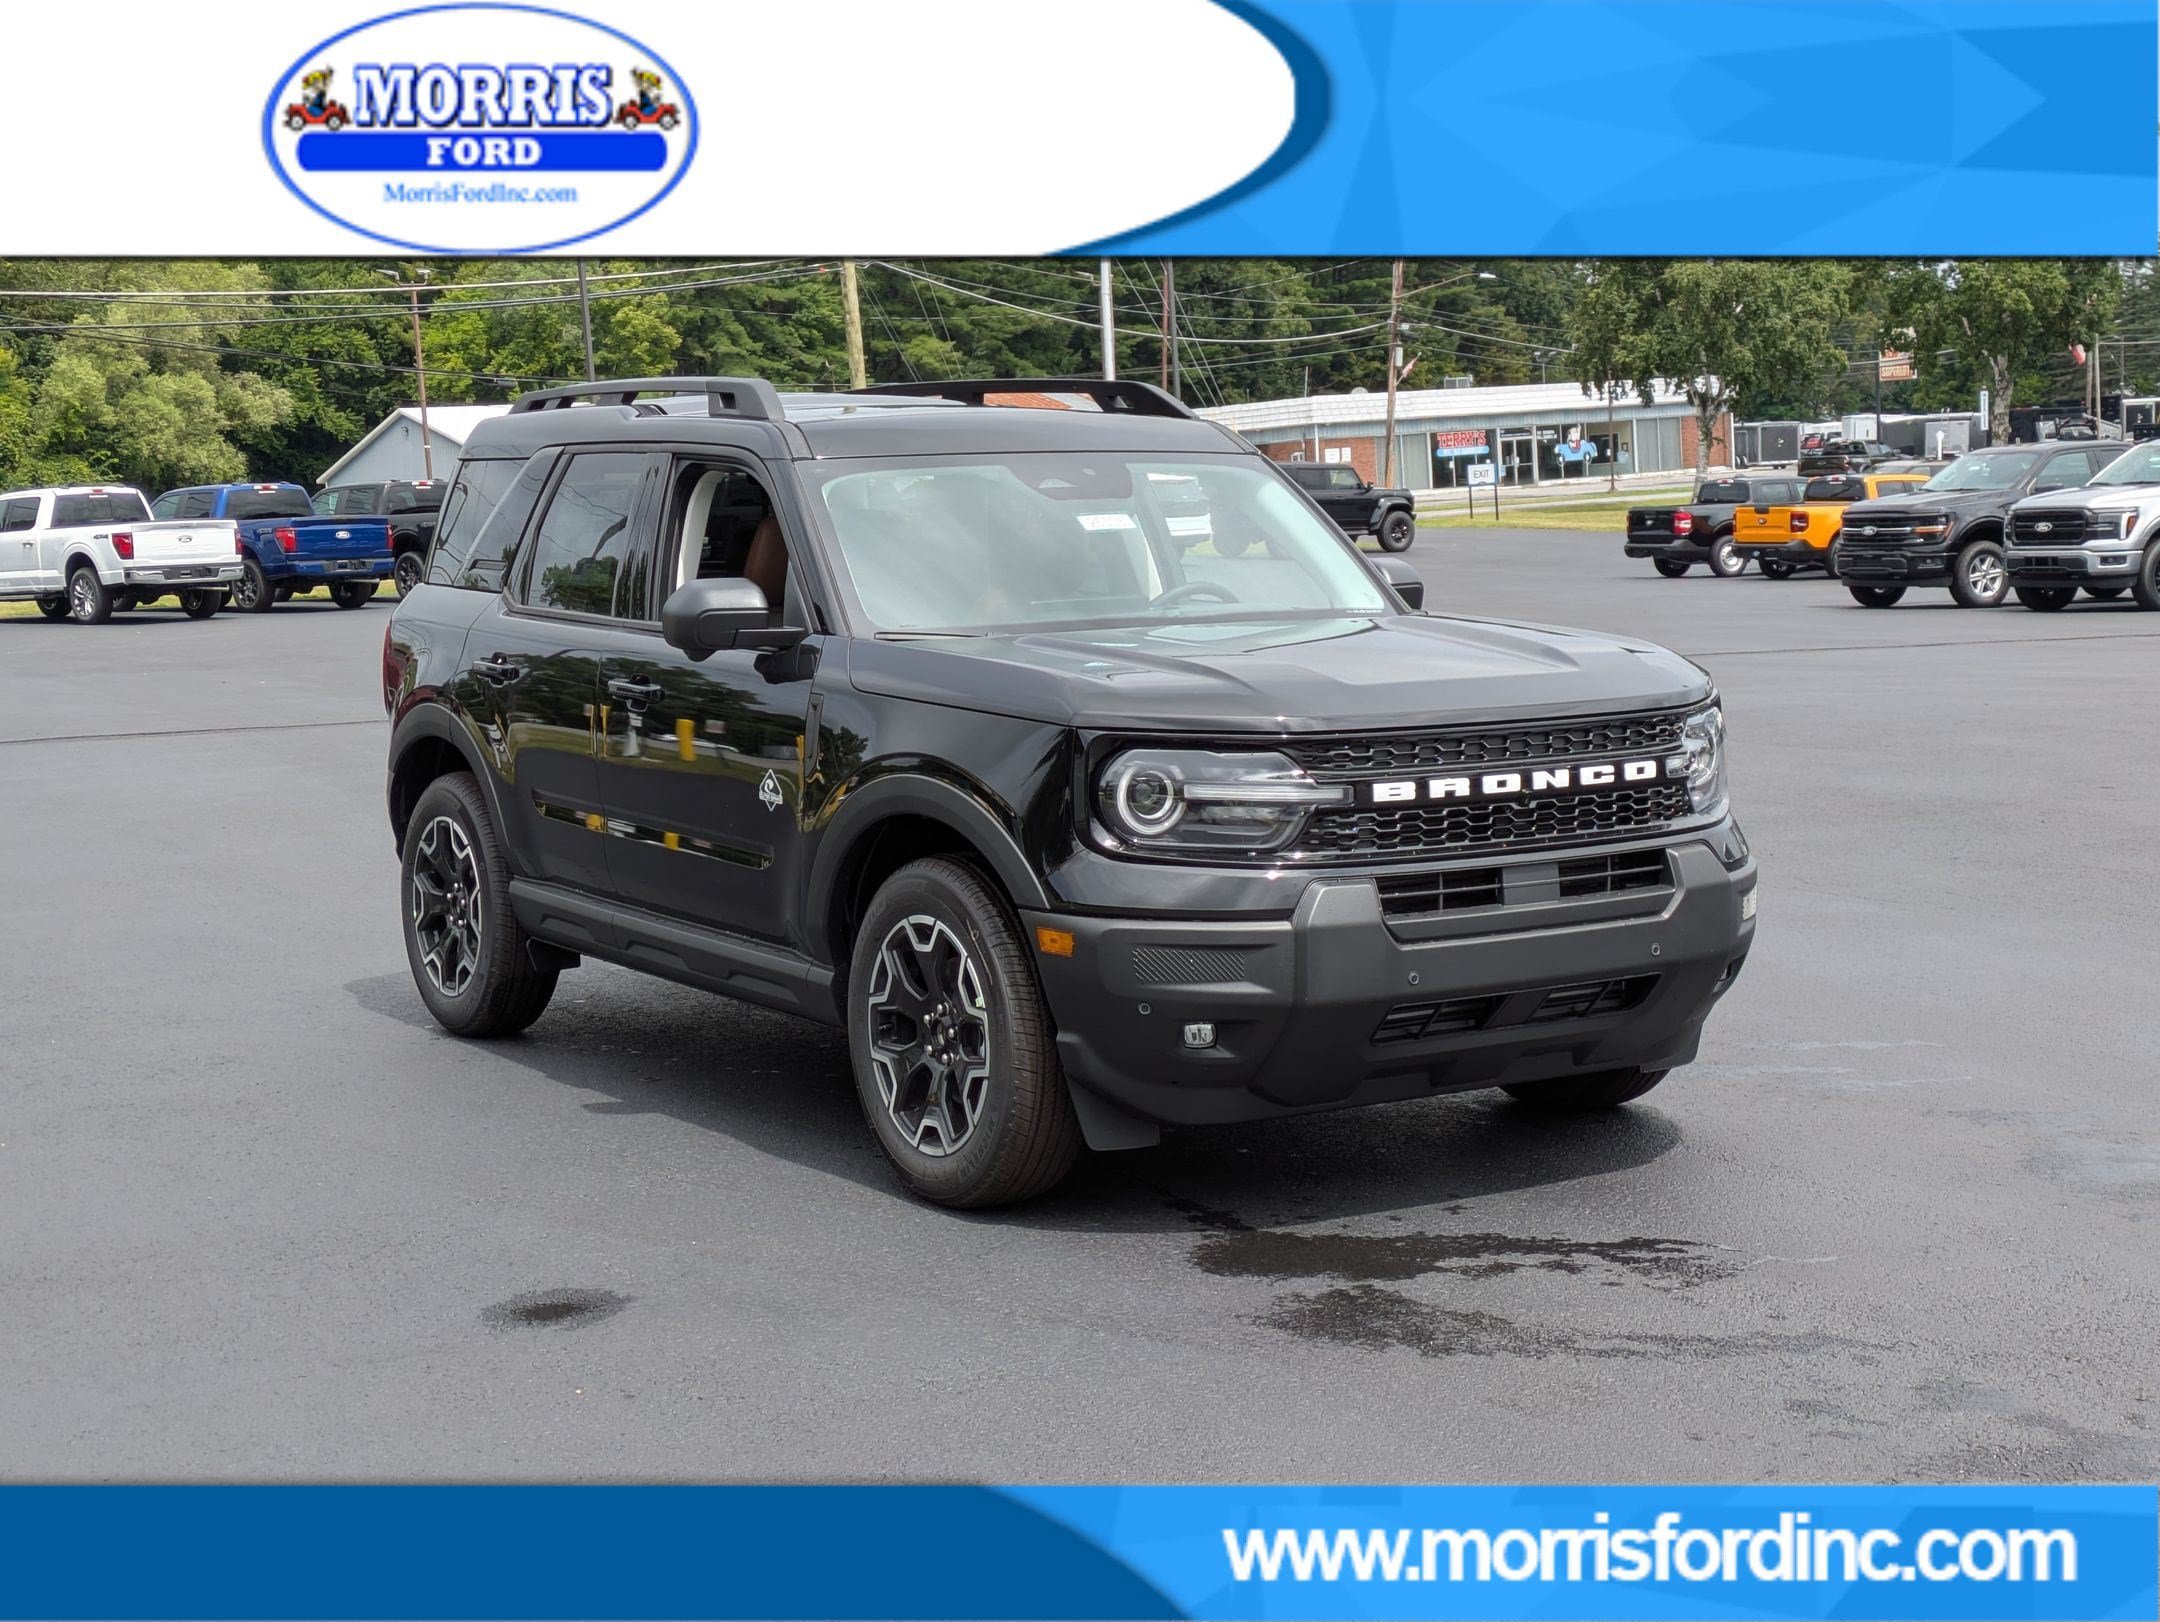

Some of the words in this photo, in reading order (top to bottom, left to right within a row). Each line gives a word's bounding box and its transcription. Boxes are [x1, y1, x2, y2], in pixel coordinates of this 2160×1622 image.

[1437, 430, 1486, 447] TERRY'S
[1473, 470, 1489, 479] EXIT
[1372, 760, 1657, 802] BRONCO
